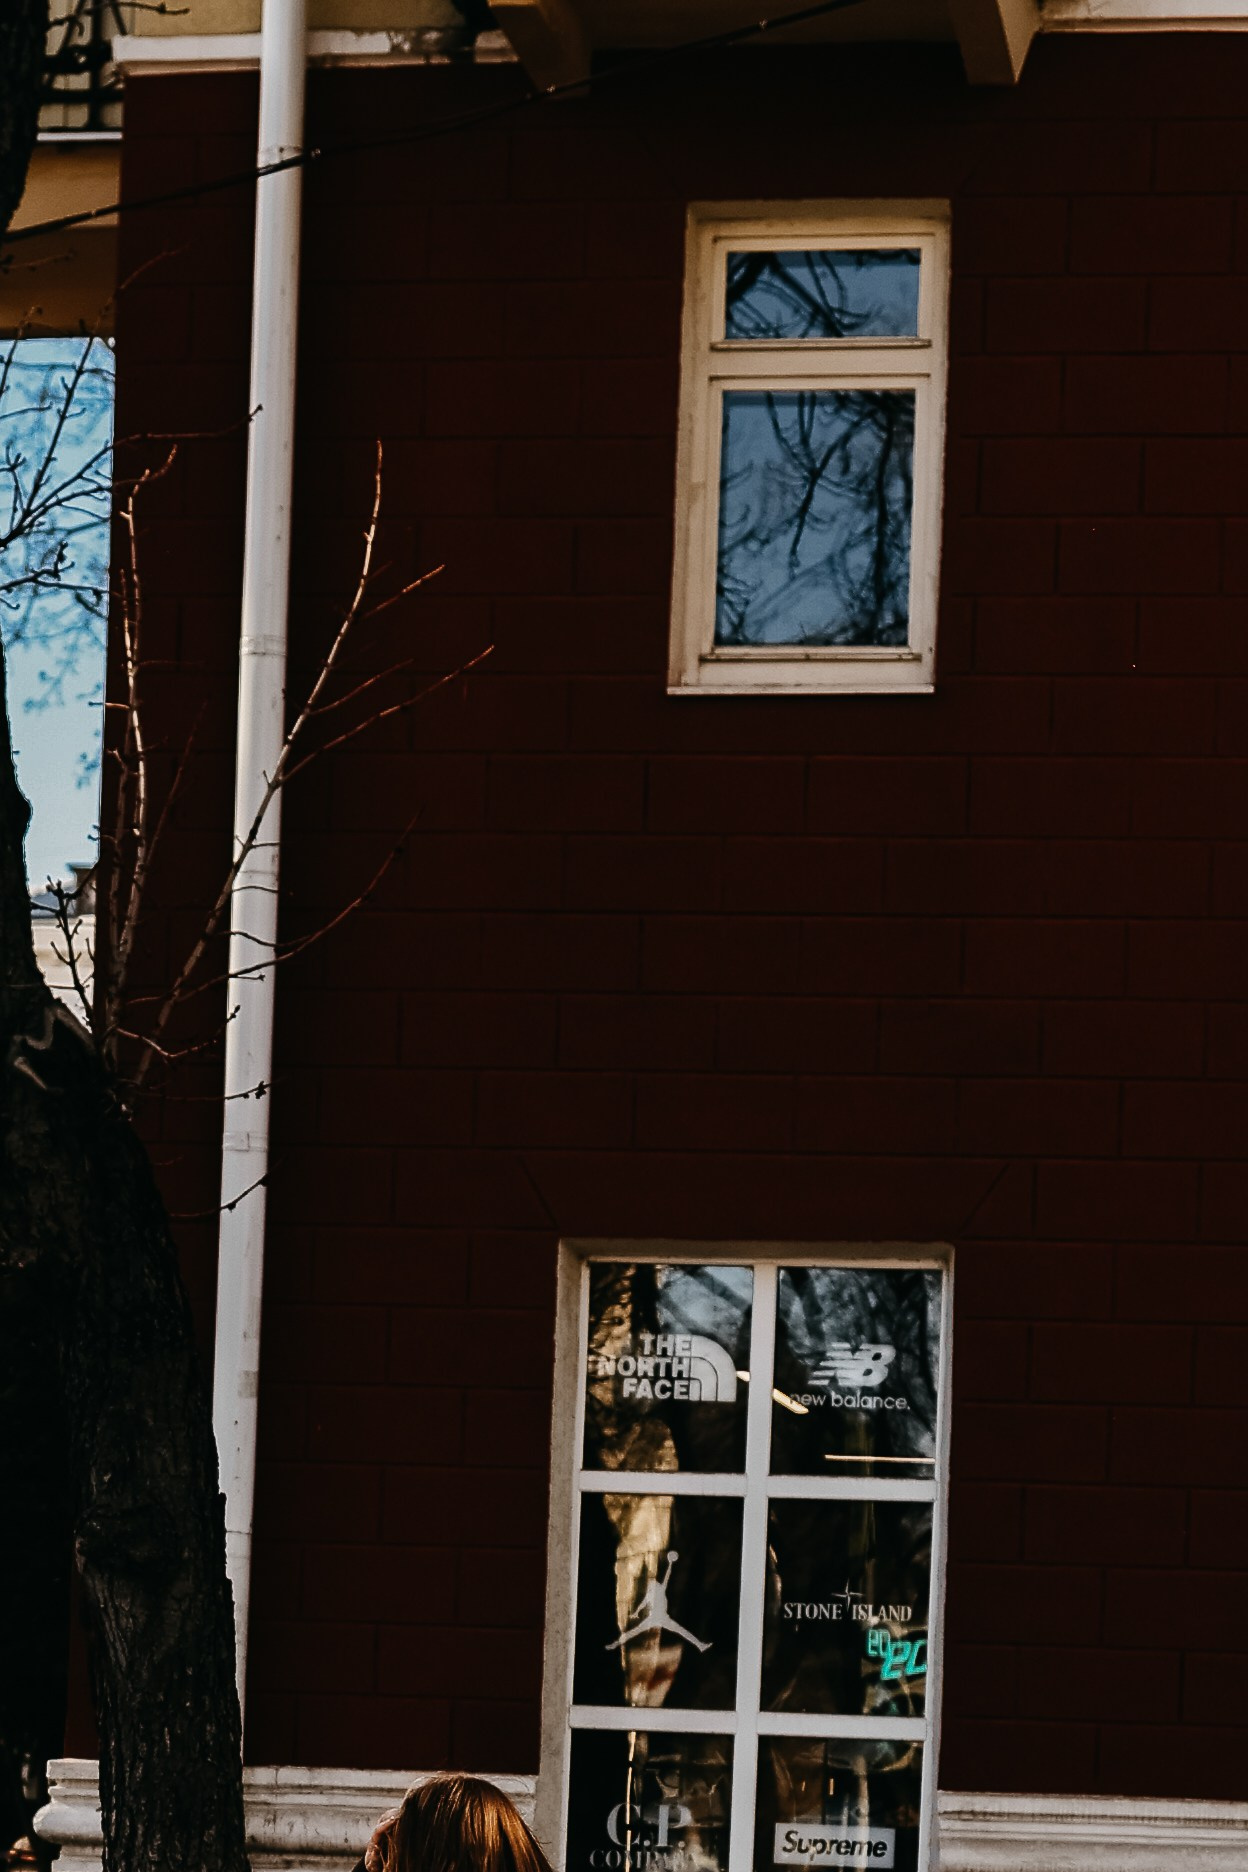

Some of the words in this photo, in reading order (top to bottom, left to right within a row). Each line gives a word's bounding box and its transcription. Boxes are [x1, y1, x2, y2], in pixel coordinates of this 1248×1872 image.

[639, 1333, 692, 1356] THE
[596, 1355, 690, 1378] NORTH
[622, 1377, 690, 1400] FACE
[790, 1393, 827, 1407] new
[783, 1602, 843, 1621] STONE
[851, 1603, 912, 1622] ISLAND
[606, 1803, 694, 1847] C.P.
[782, 1829, 888, 1861] Supreme
[589, 1849, 700, 1870] COMPA
